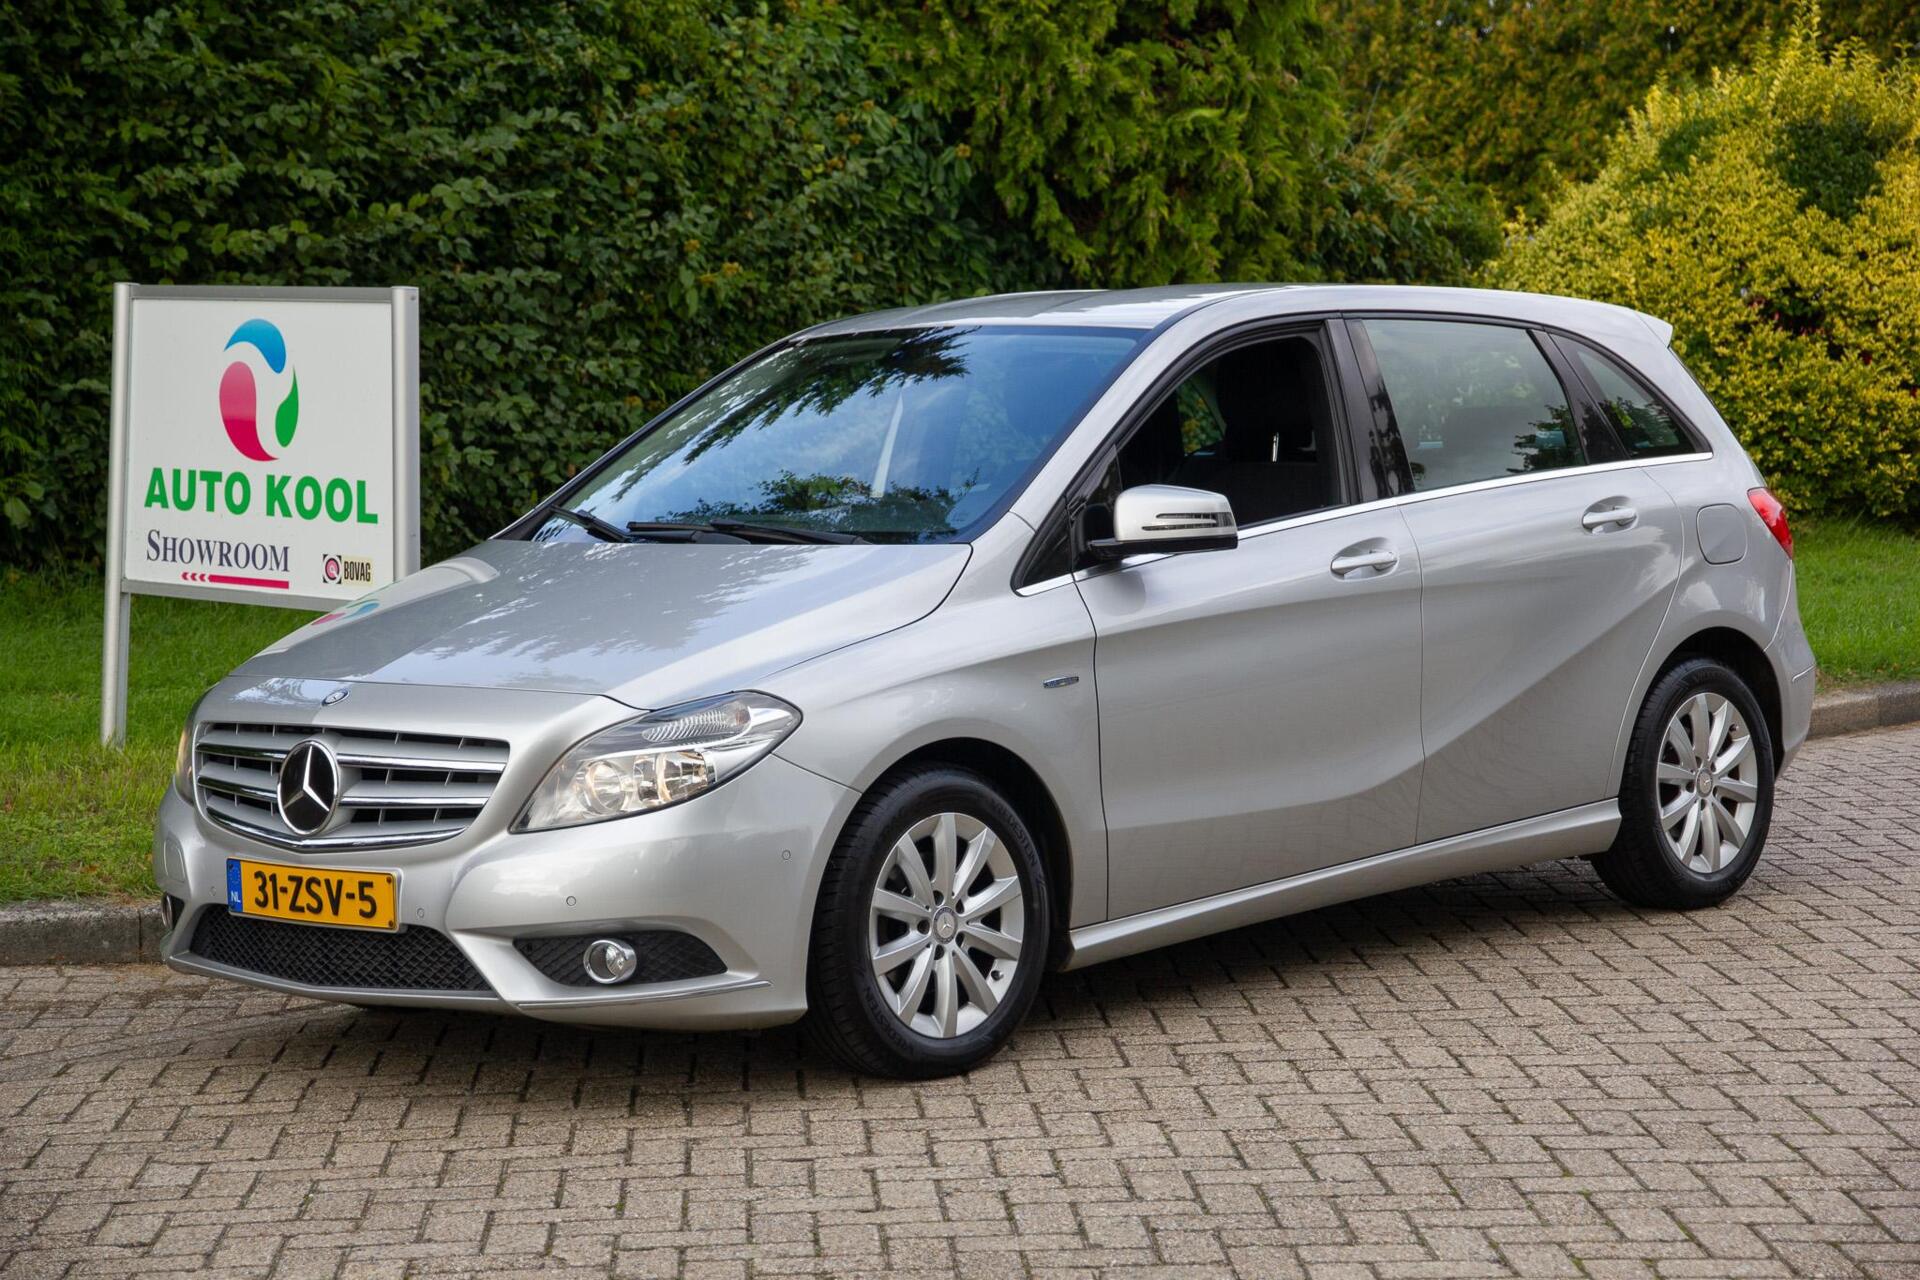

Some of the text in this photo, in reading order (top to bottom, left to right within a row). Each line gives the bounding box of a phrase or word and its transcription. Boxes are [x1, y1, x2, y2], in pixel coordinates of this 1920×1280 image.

[144, 467, 379, 524] AUTO KOOL
[146, 529, 290, 572] SHOWROOM
[343, 561, 371, 582] BOVAG
[230, 870, 377, 919] NL 31-ZSV-5
